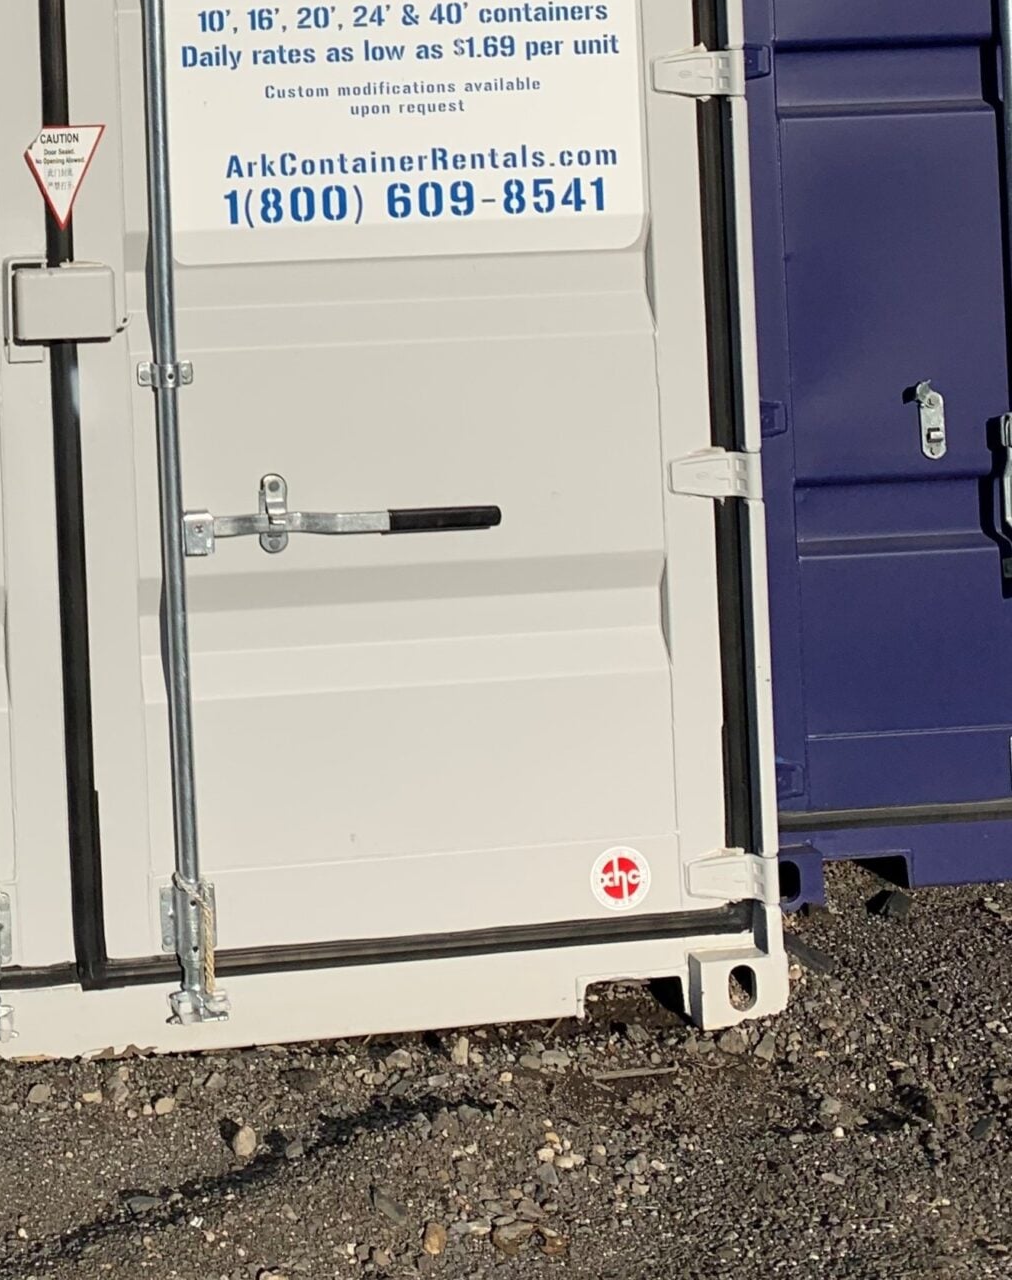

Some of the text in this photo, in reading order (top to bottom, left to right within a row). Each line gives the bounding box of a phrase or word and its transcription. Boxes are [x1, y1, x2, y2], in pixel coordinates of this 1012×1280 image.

[401, 4, 419, 26] &
[479, 1, 608, 24] containers
[181, 34, 619, 70] Daily rates as low as $1.69 per unit
[264, 77, 541, 99] Custom modifications available
[350, 99, 465, 116] upon request
[40, 133, 79, 144] CAUTION
[225, 144, 618, 179] ArkContainerRentals.com
[224, 176, 606, 228] 1(800) 609-8541
